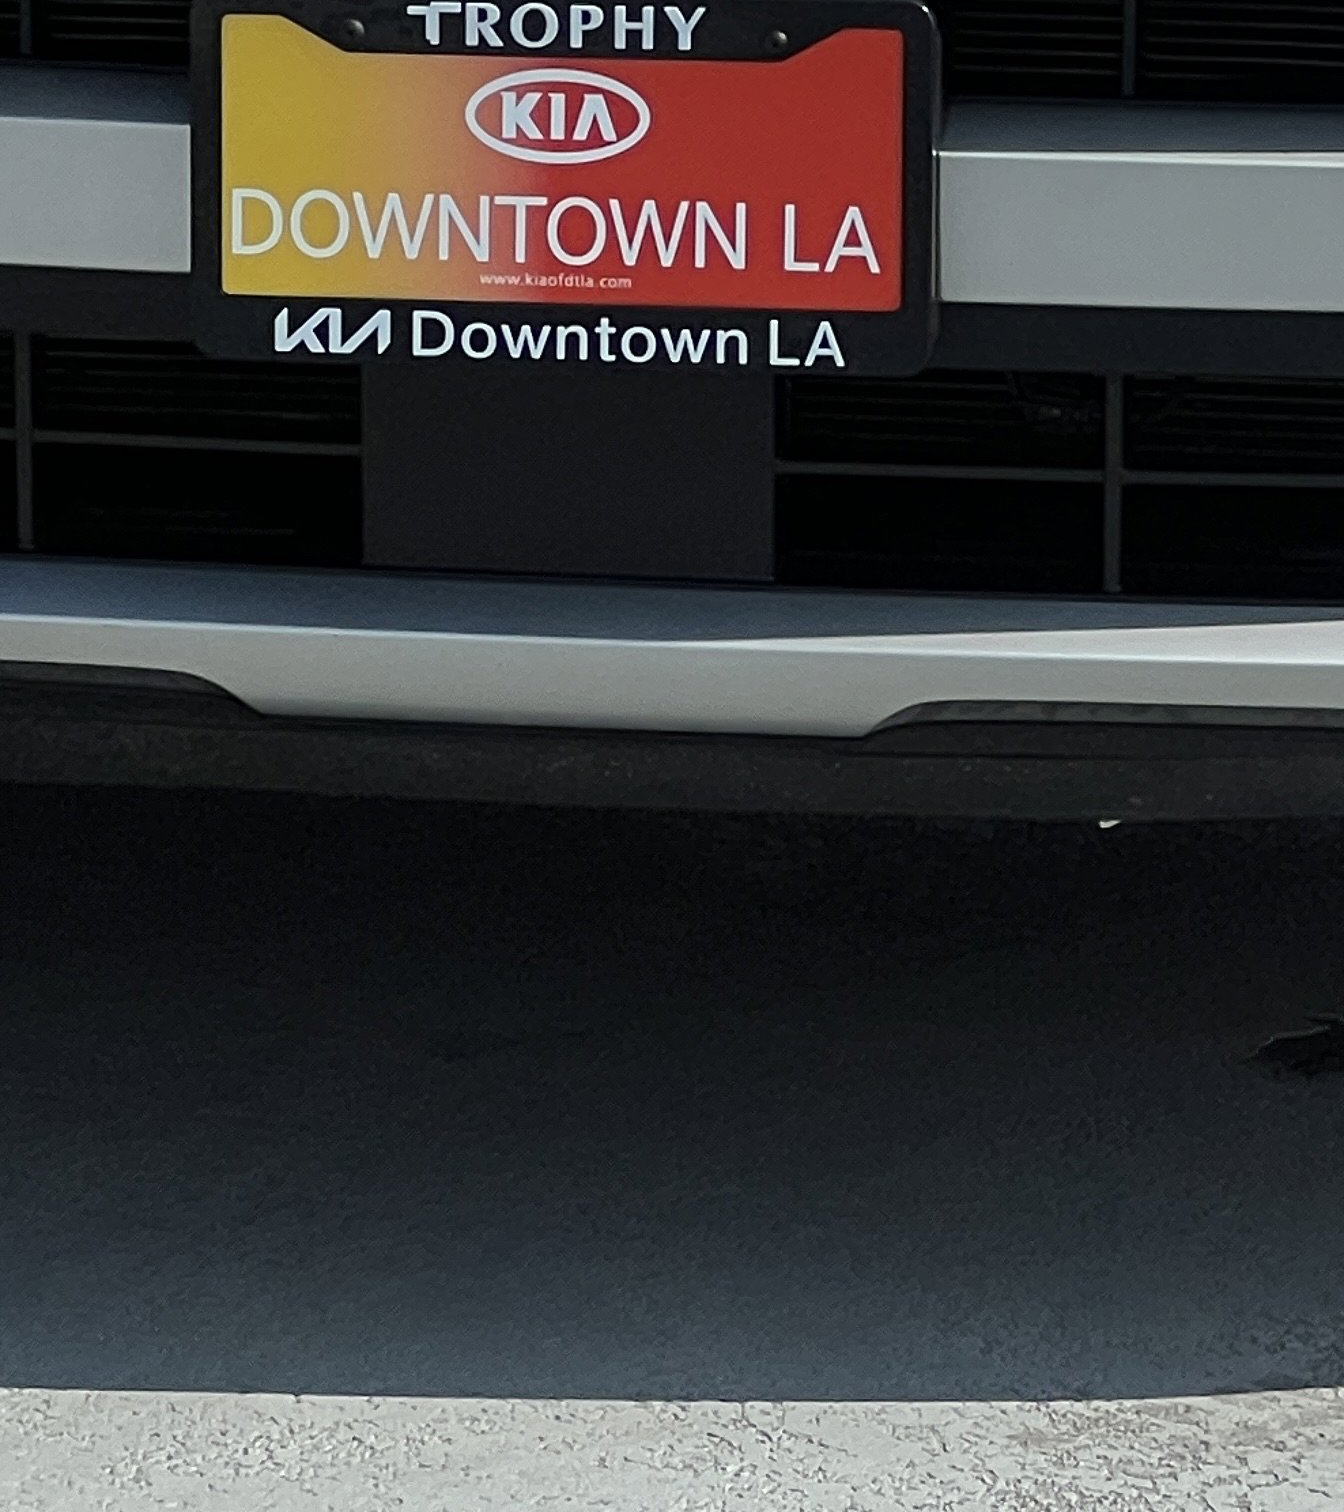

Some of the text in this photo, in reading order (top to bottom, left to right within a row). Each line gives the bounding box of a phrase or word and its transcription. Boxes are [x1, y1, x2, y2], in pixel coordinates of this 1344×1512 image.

[407, 1, 706, 51] TROPHY
[499, 91, 619, 143] KIA
[230, 187, 881, 274] DOWNTOWN LA
[412, 309, 748, 365] Downtown
[769, 319, 845, 367] LA
